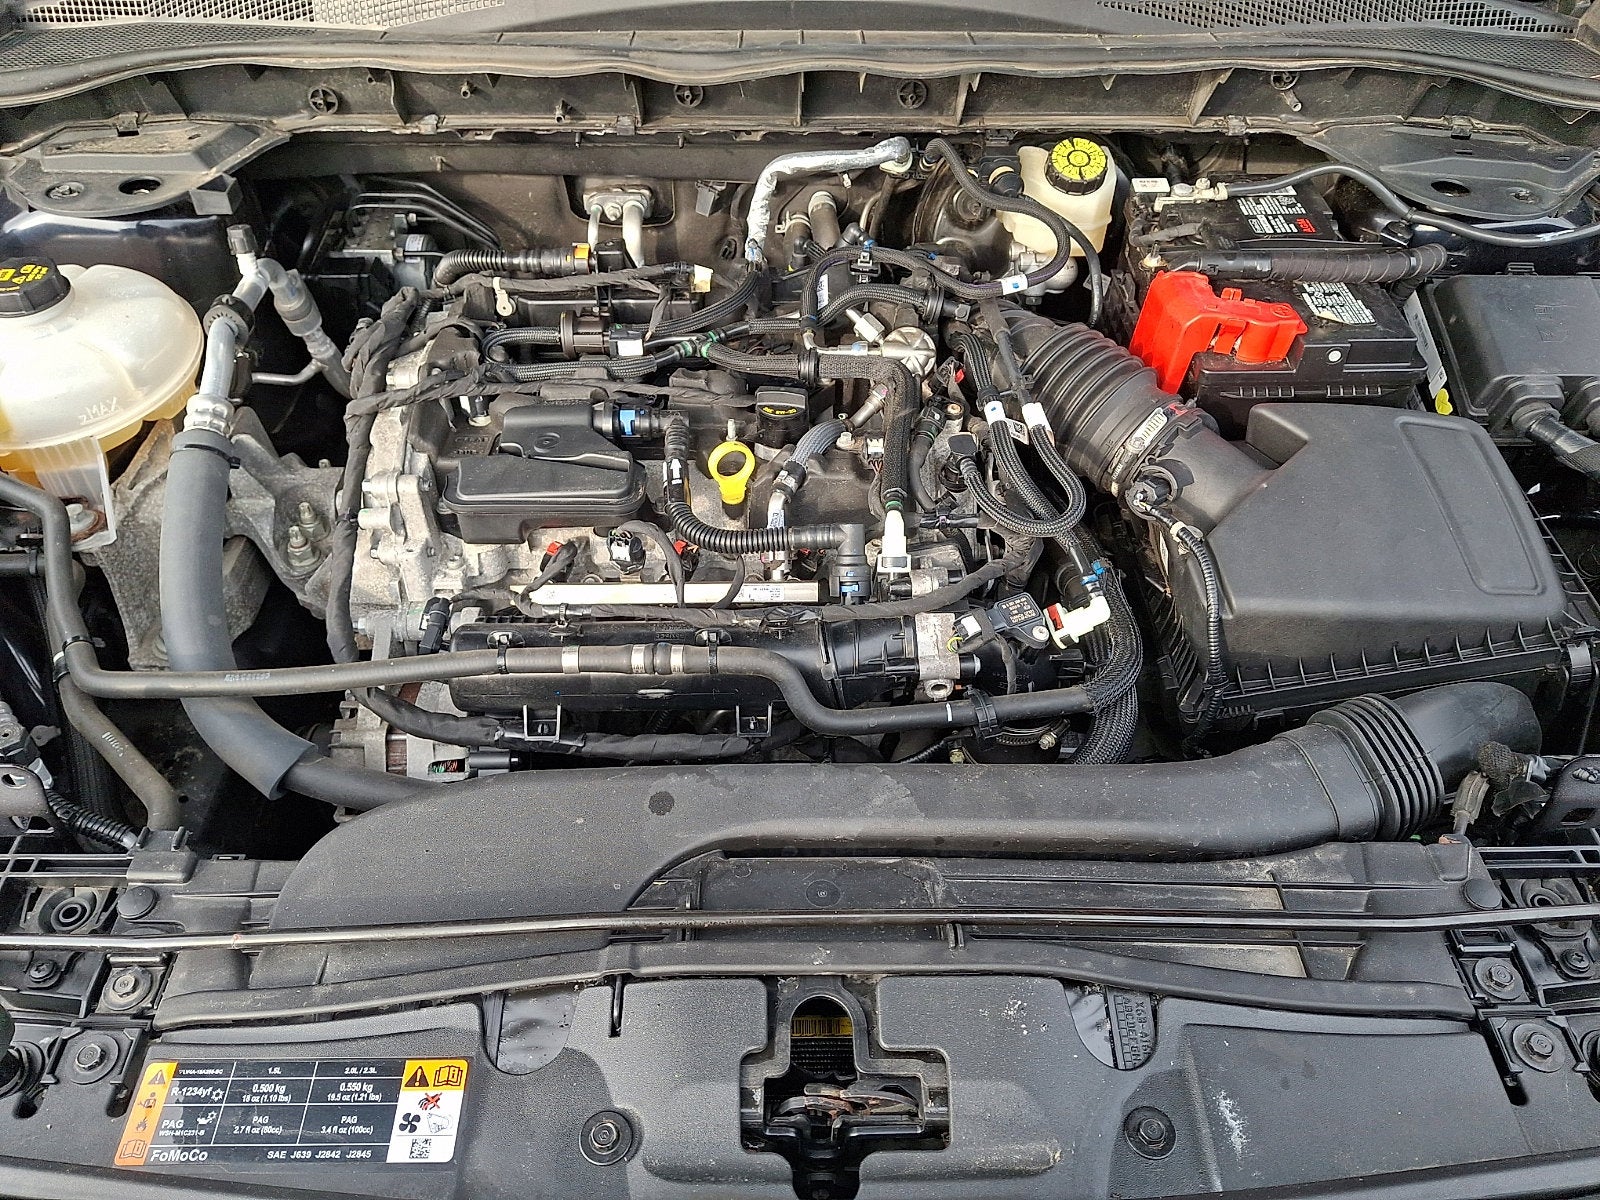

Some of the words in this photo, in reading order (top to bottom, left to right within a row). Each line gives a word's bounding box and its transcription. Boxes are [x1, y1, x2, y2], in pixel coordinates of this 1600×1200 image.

[170, 1087, 212, 1098] R-1234yf
[252, 1083, 274, 1093] 0.500
[275, 1083, 286, 1094] kg
[340, 1082, 362, 1092] 0.550
[362, 1082, 374, 1093] kg
[278, 1094, 291, 1104] lbs)
[327, 1093, 342, 1102] 19.5
[342, 1094, 352, 1102] oz
[350, 1093, 368, 1102] (1.21
[368, 1093, 382, 1102] lbs)
[161, 1119, 184, 1129] PAG
[252, 1116, 269, 1124] PAG
[340, 1115, 358, 1124] PAG
[233, 1126, 245, 1134] 2.7
[320, 1125, 332, 1134] 3.4
[348, 1125, 374, 1135] (100cc)
[149, 1149, 209, 1162] FoMoCo
[267, 1150, 286, 1159] SAE
[290, 1150, 311, 1159] J639
[314, 1150, 341, 1159] J2842
[345, 1150, 372, 1159] J2845
